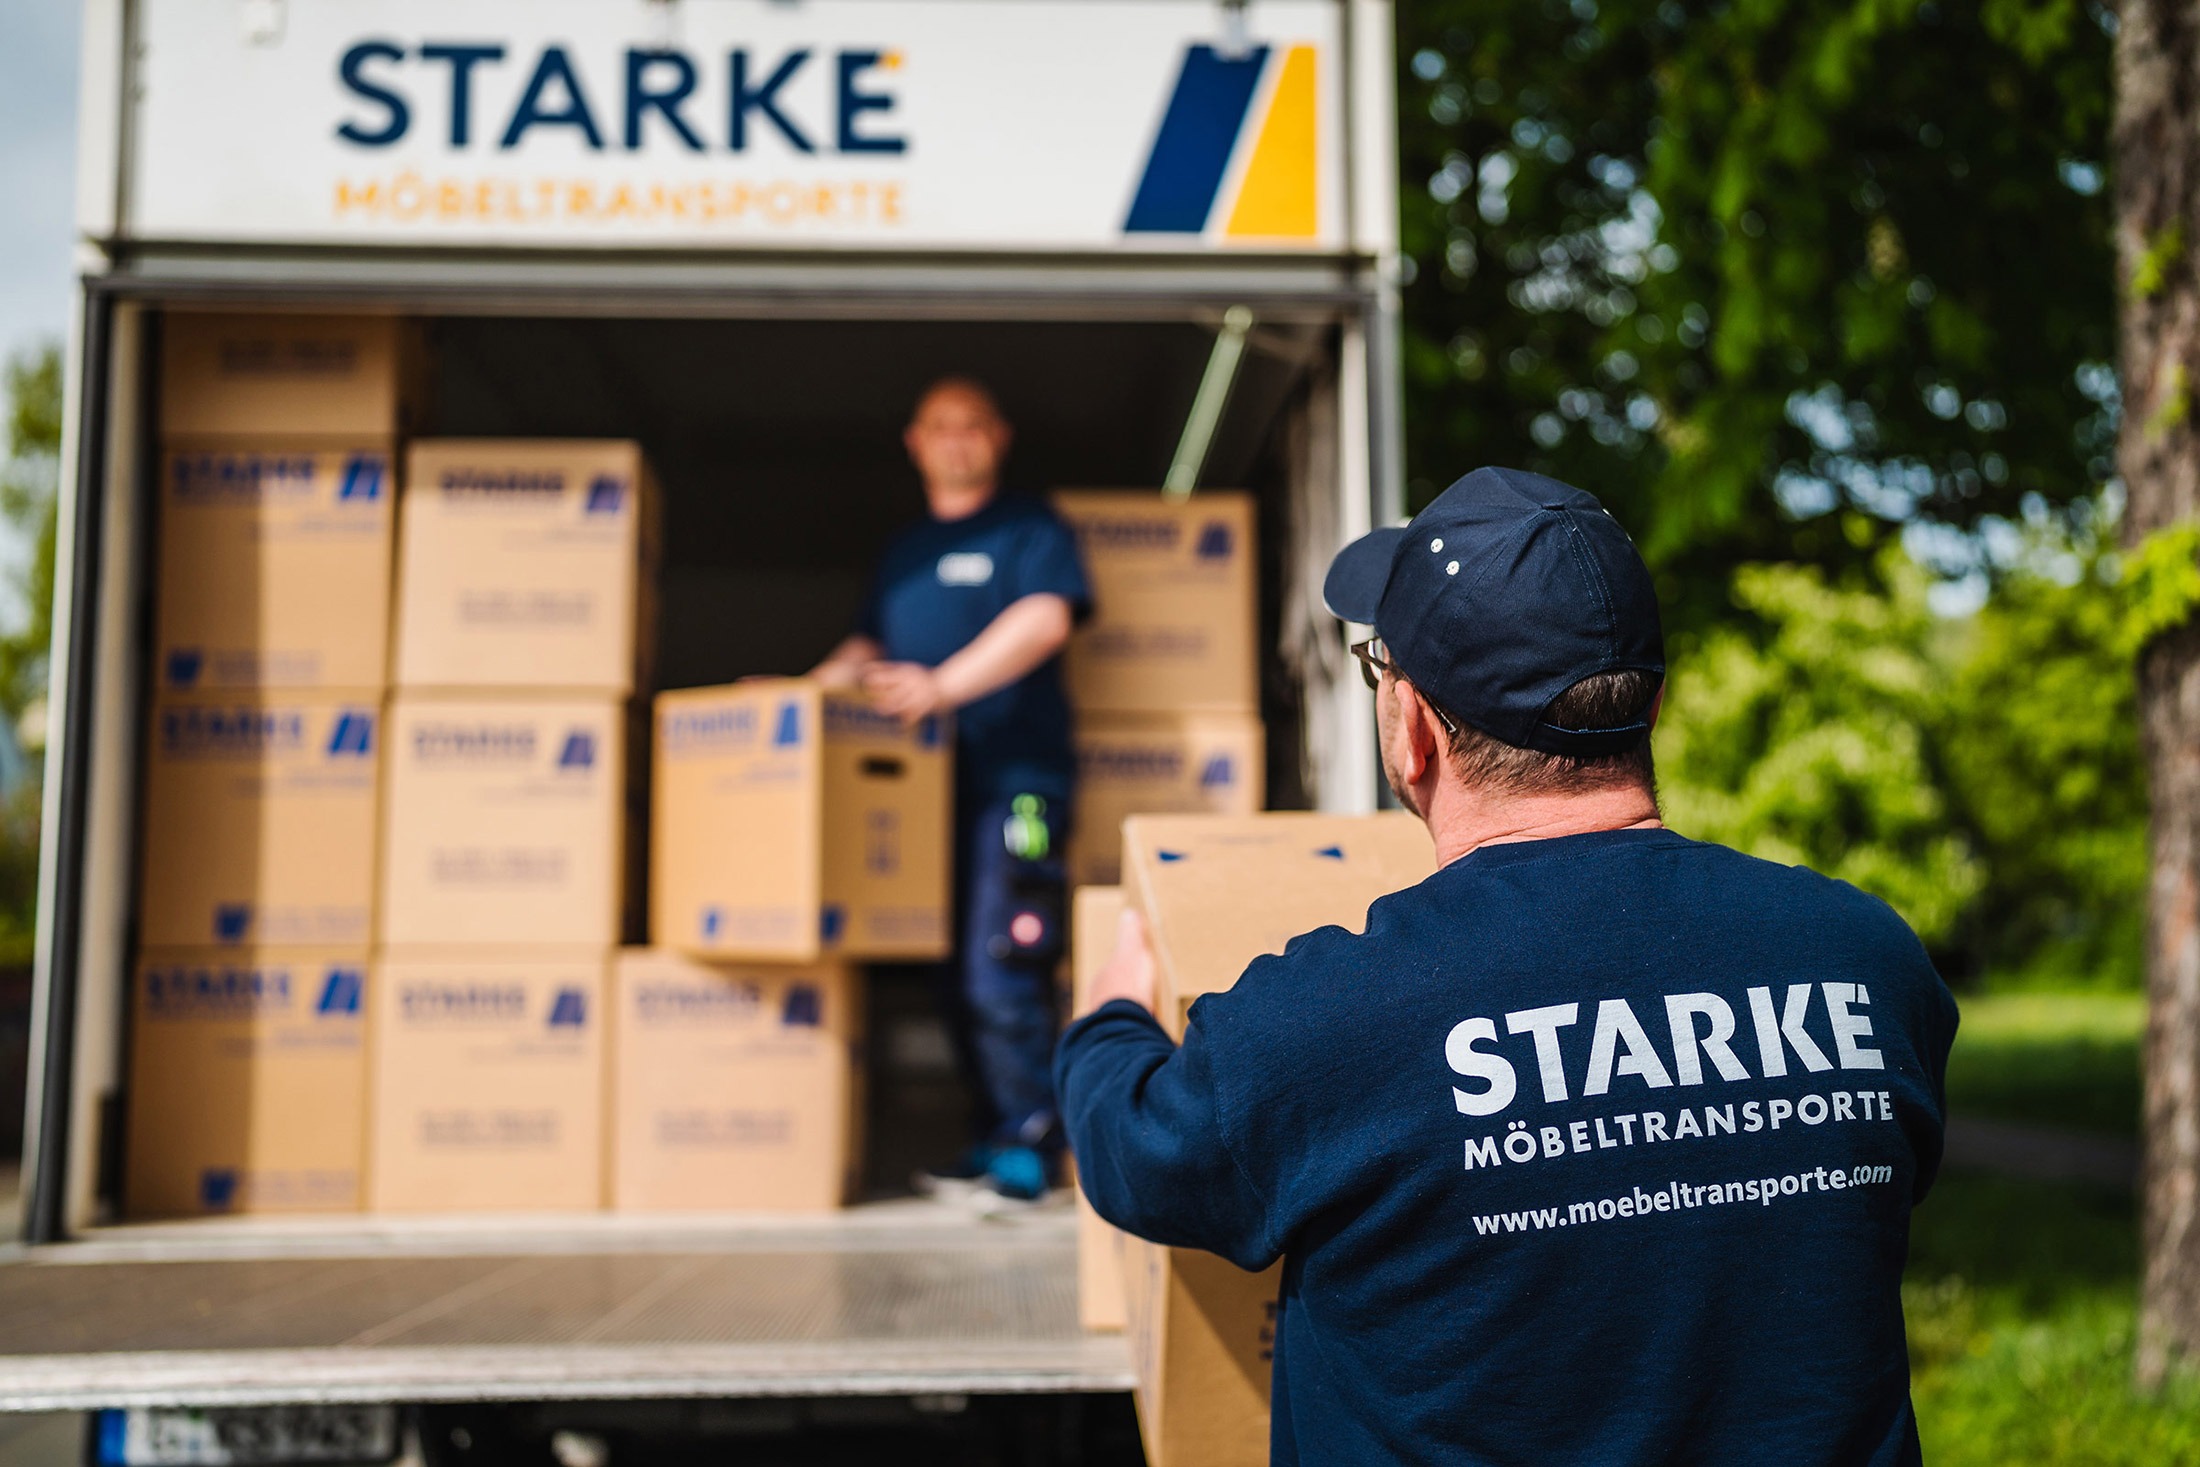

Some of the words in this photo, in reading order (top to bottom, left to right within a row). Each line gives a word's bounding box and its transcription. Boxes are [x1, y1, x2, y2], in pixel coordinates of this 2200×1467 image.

[335, 40, 911, 156] STARKE
[333, 166, 906, 226] MÖBELTRANSPORTE
[1444, 981, 1885, 1117] STARKE
[1463, 1090, 1894, 1171] MÖBELTRANSPORTE
[1472, 1163, 1893, 1236] www.moebeltransporte.com
